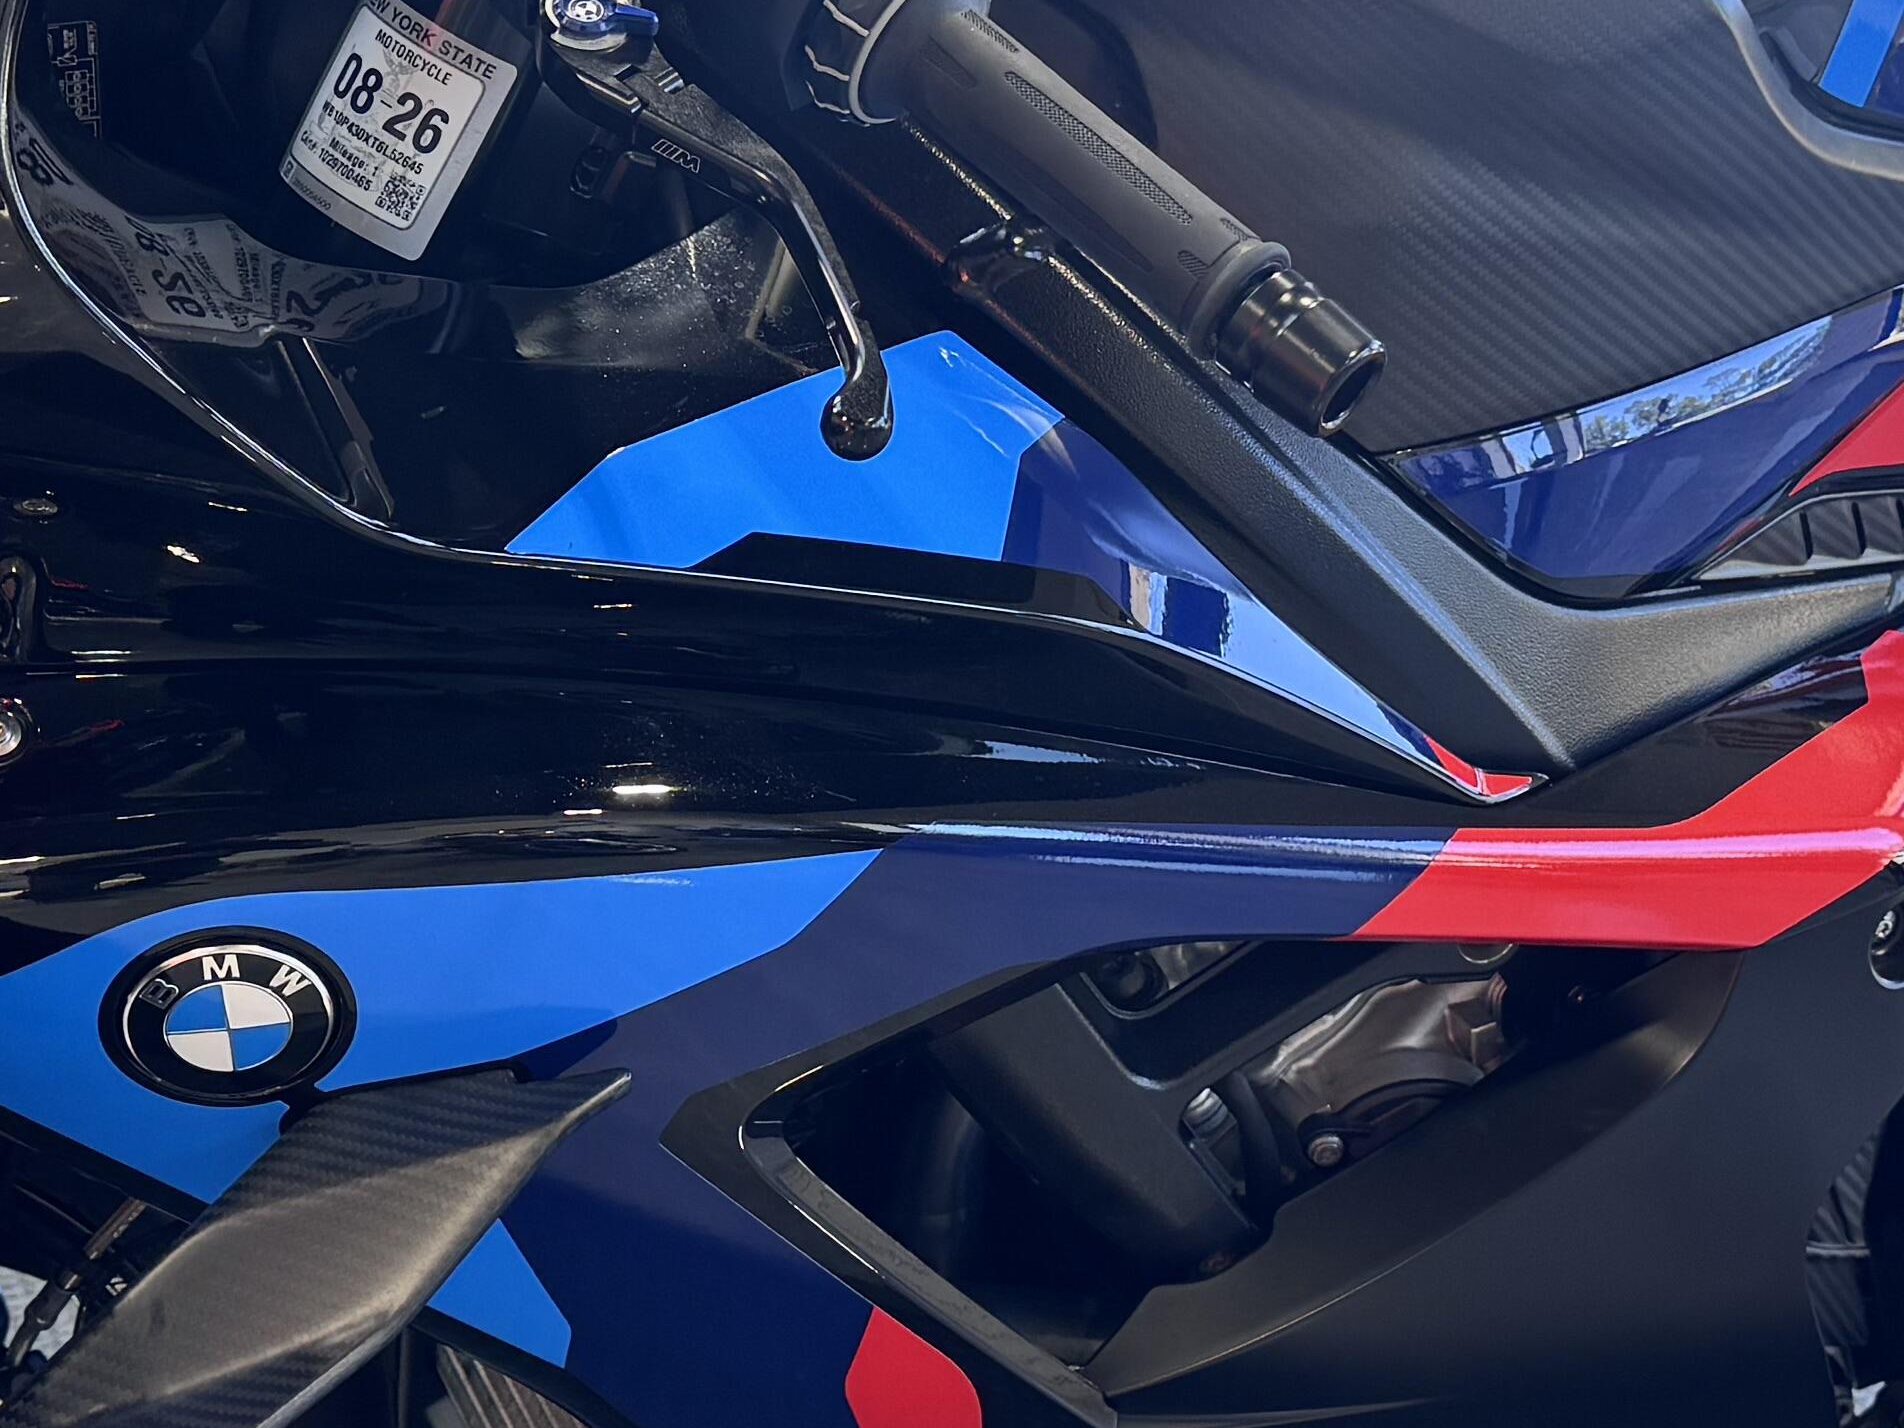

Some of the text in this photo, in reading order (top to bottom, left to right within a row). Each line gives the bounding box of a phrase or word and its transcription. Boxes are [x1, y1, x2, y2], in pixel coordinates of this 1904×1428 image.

[374, 28, 453, 86] MOTORCYCLE
[391, 6, 438, 47] YORK
[438, 39, 497, 80] STATE
[333, 53, 450, 155] 08-26
[329, 136, 369, 172] Mileage:
[138, 953, 312, 1009] BMW
